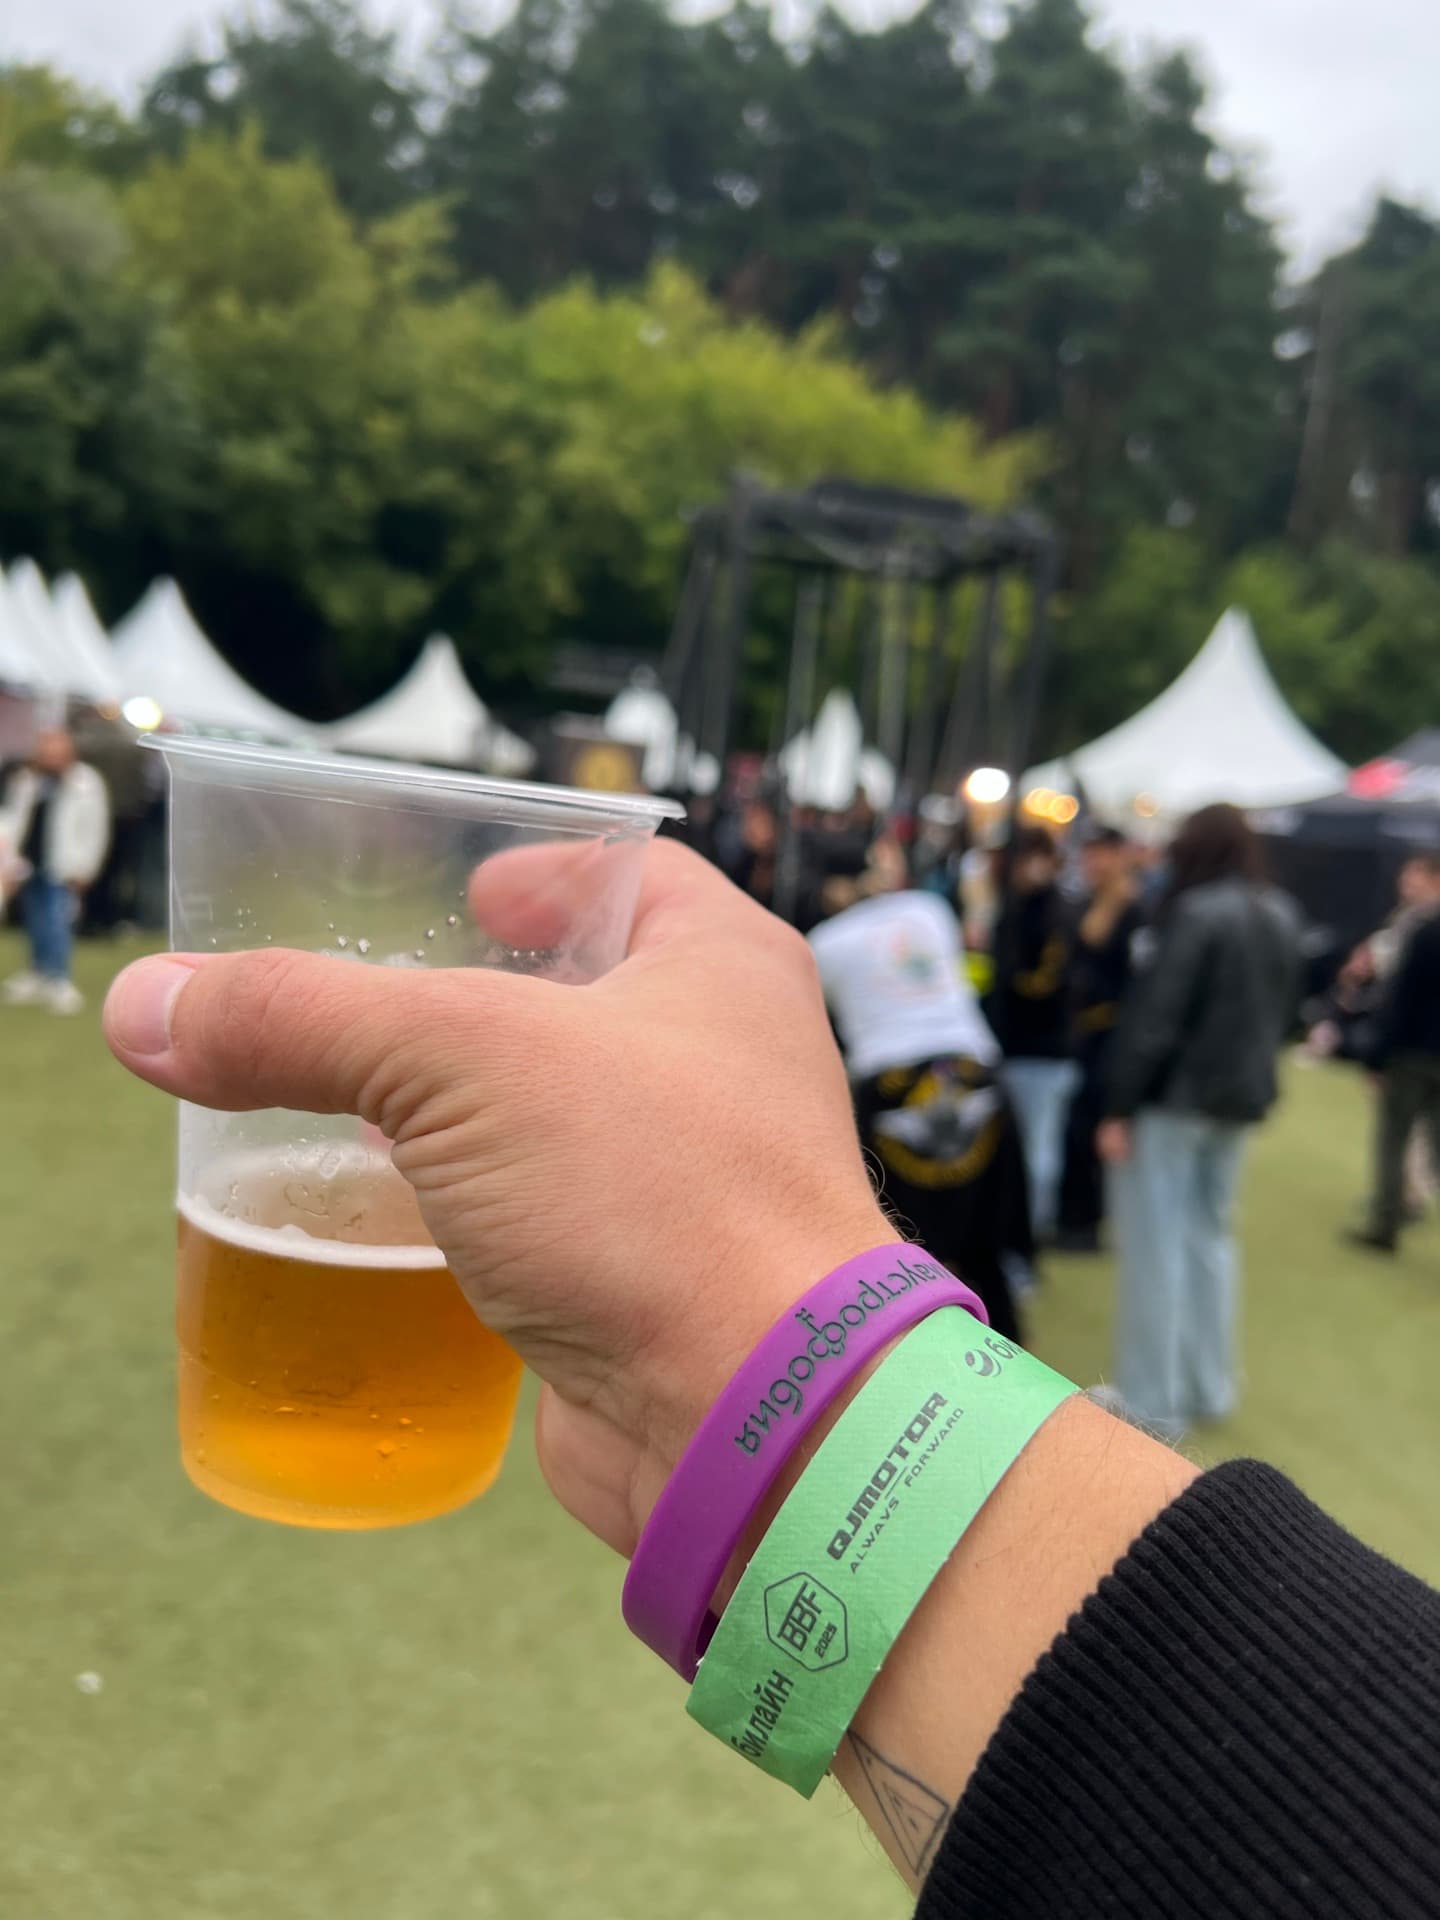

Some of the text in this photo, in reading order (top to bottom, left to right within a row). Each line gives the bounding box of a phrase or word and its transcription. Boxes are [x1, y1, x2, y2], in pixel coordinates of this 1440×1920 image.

[734, 1259, 954, 1456] лаустрофобия
[827, 1392, 948, 1560] QJMOTOR
[850, 1408, 964, 1574] ALWAYS FORWARD
[777, 1580, 822, 1652] BBF
[731, 1669, 795, 1758] билайн
